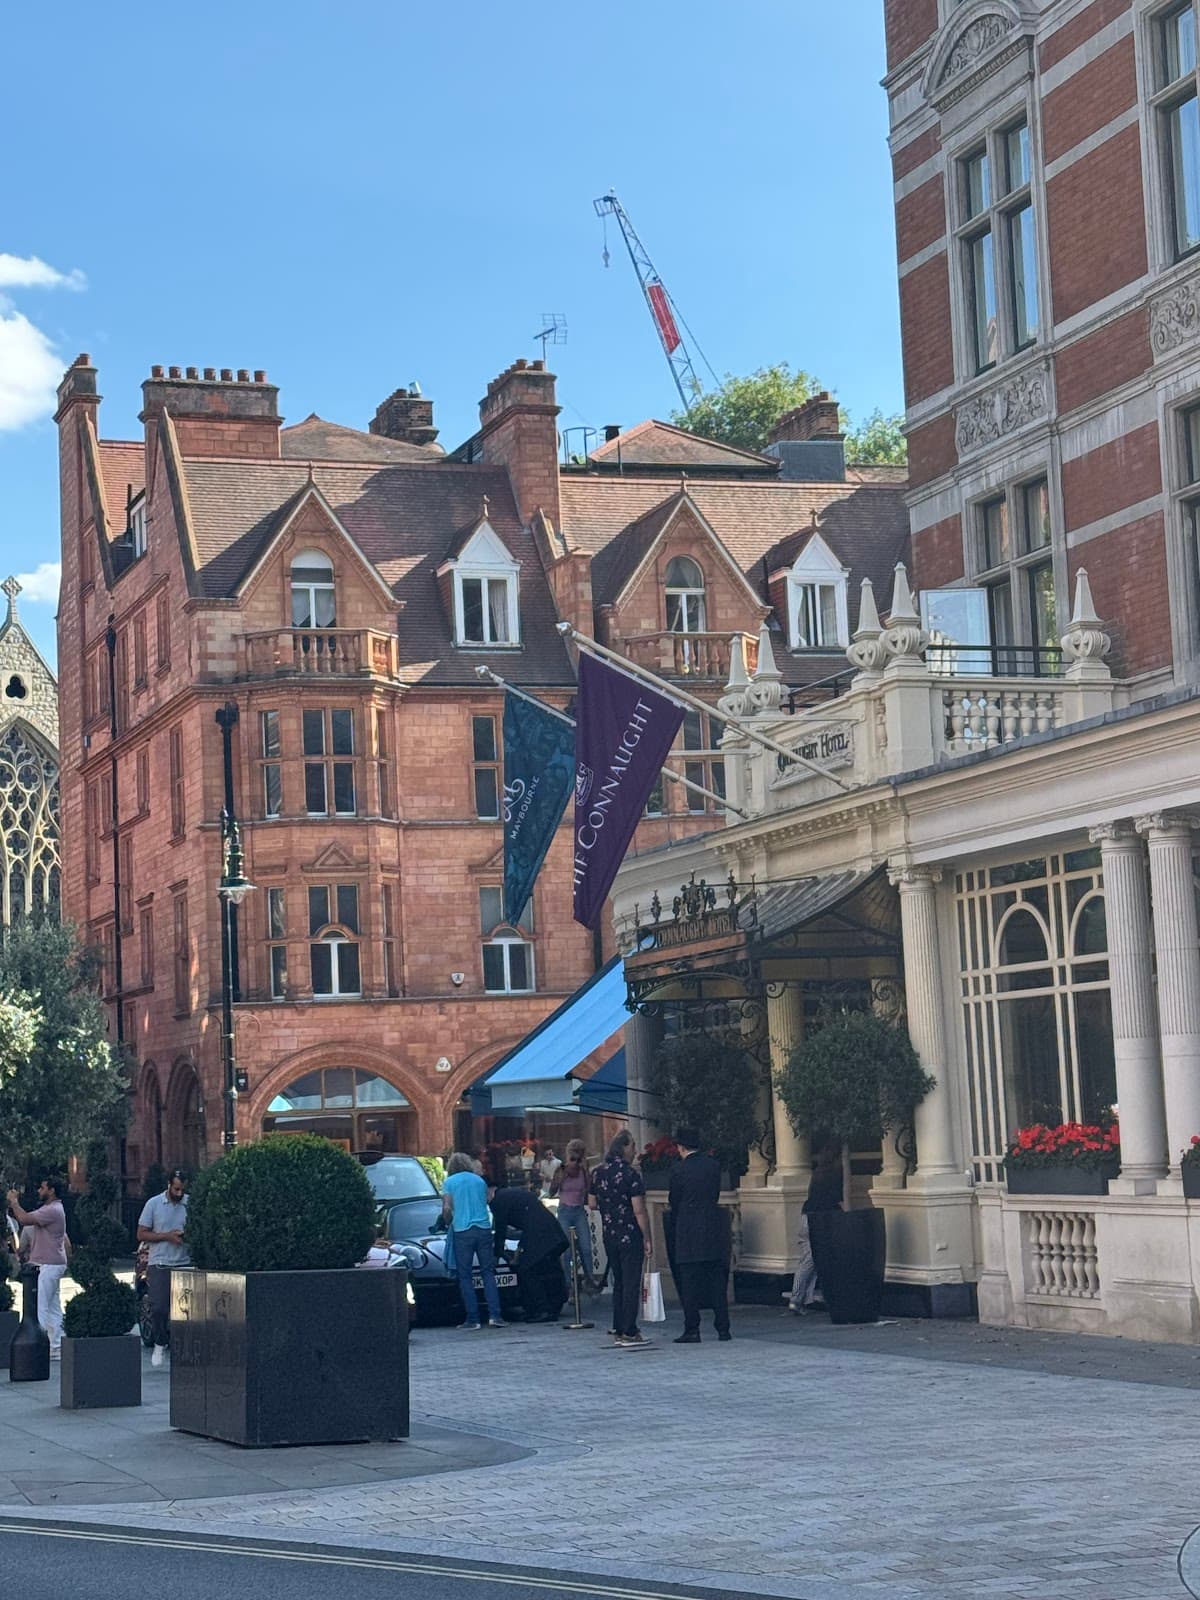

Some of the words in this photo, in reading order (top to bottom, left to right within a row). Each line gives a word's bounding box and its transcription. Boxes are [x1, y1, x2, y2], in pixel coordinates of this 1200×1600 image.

[819, 732, 850, 758] HOTEL
[578, 697, 653, 850] CONNAUGHT
[510, 775, 540, 840] MAYBOURNE
[573, 851, 589, 895] HE
